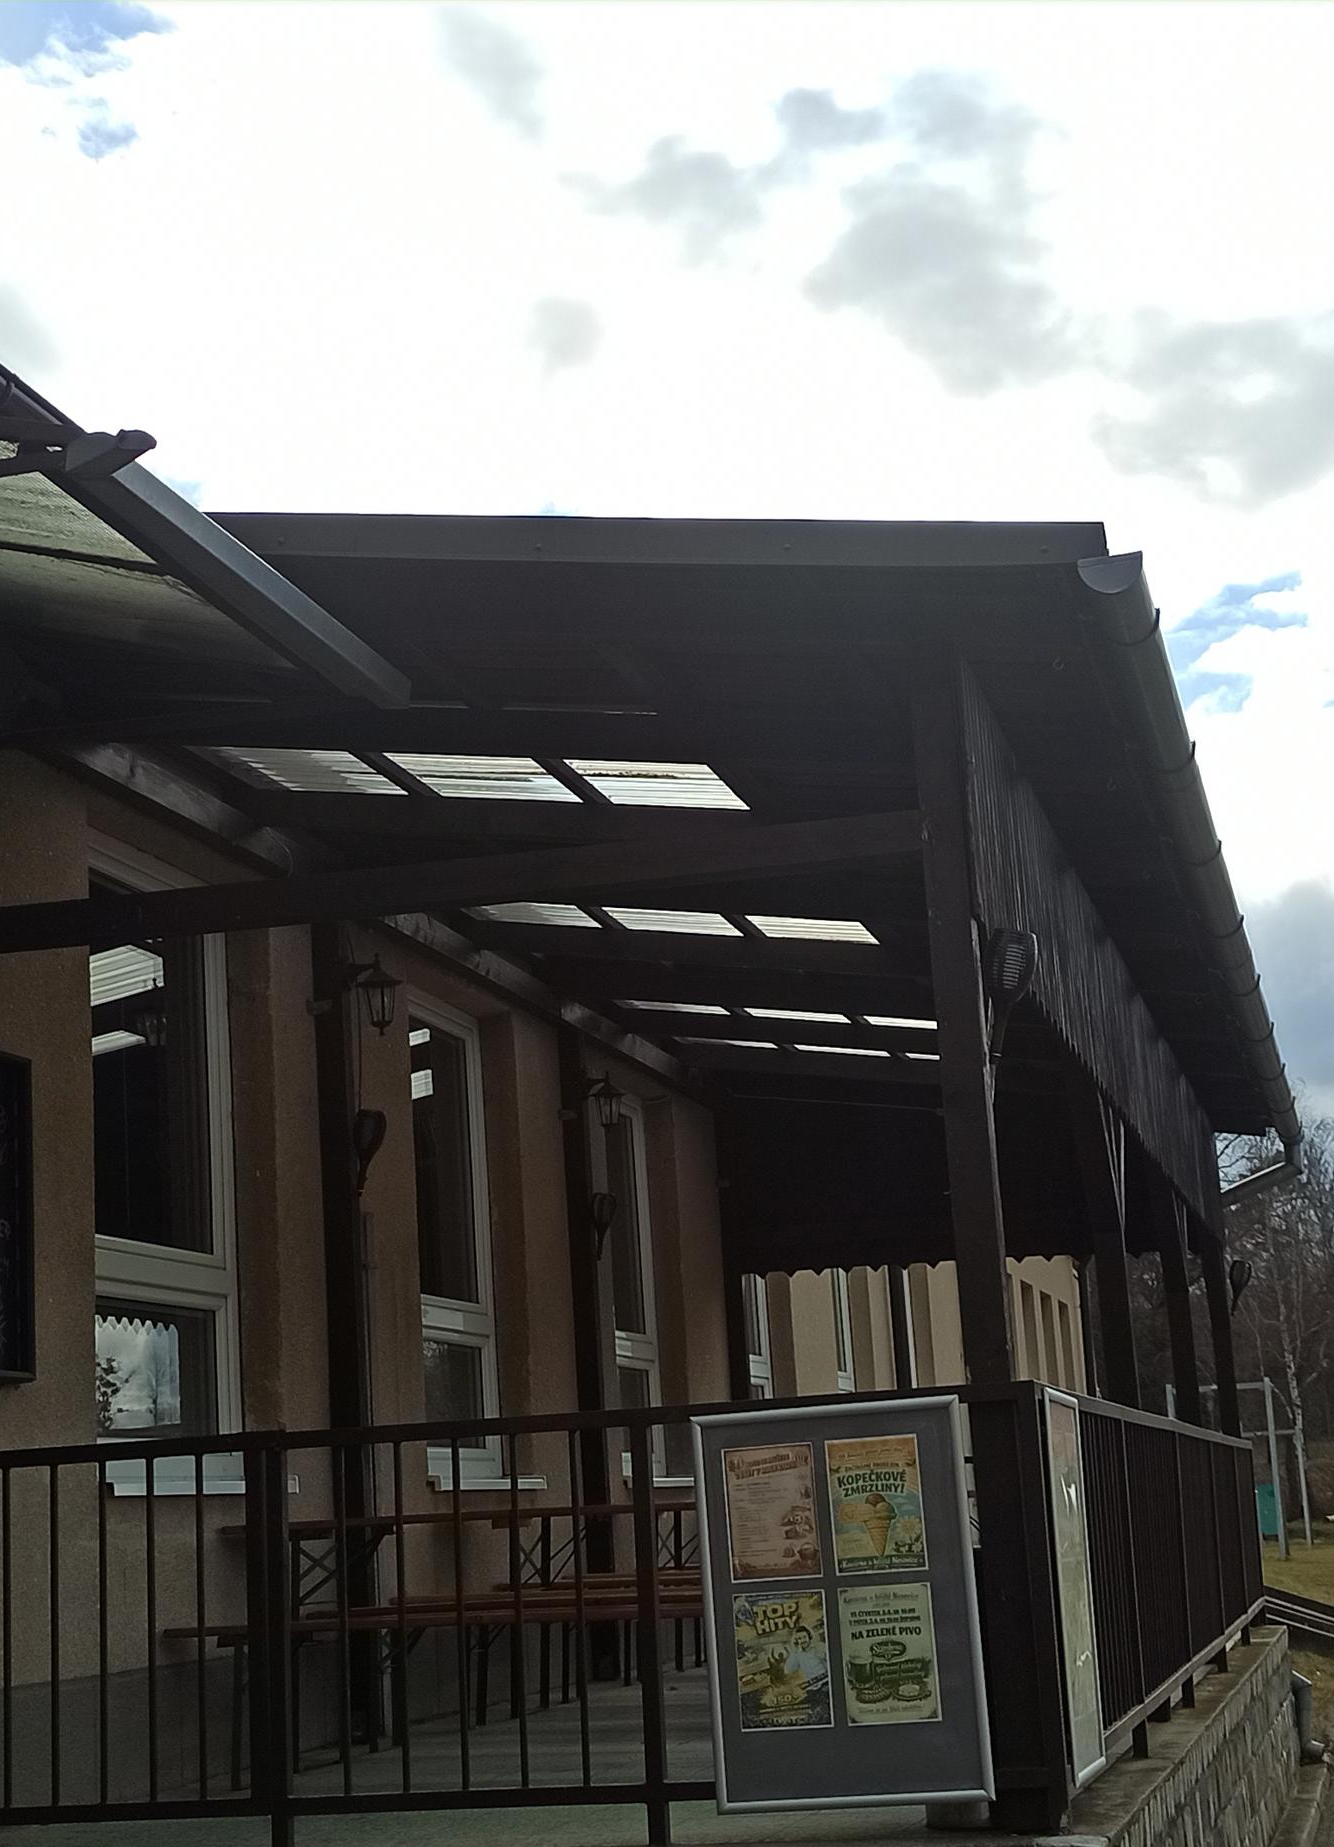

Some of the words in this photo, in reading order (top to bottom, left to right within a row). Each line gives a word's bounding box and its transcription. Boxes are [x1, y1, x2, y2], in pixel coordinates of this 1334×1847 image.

[837, 1469, 907, 1488] KOPEČKOVÉ
[843, 1483, 905, 1498] ZMRZLINY!
[753, 1602, 798, 1620] TOP
[755, 1615, 798, 1636] HITY
[851, 1630, 864, 1641] NA
[865, 1626, 897, 1638] ZELENÉ
[898, 1626, 922, 1636] PIVO
